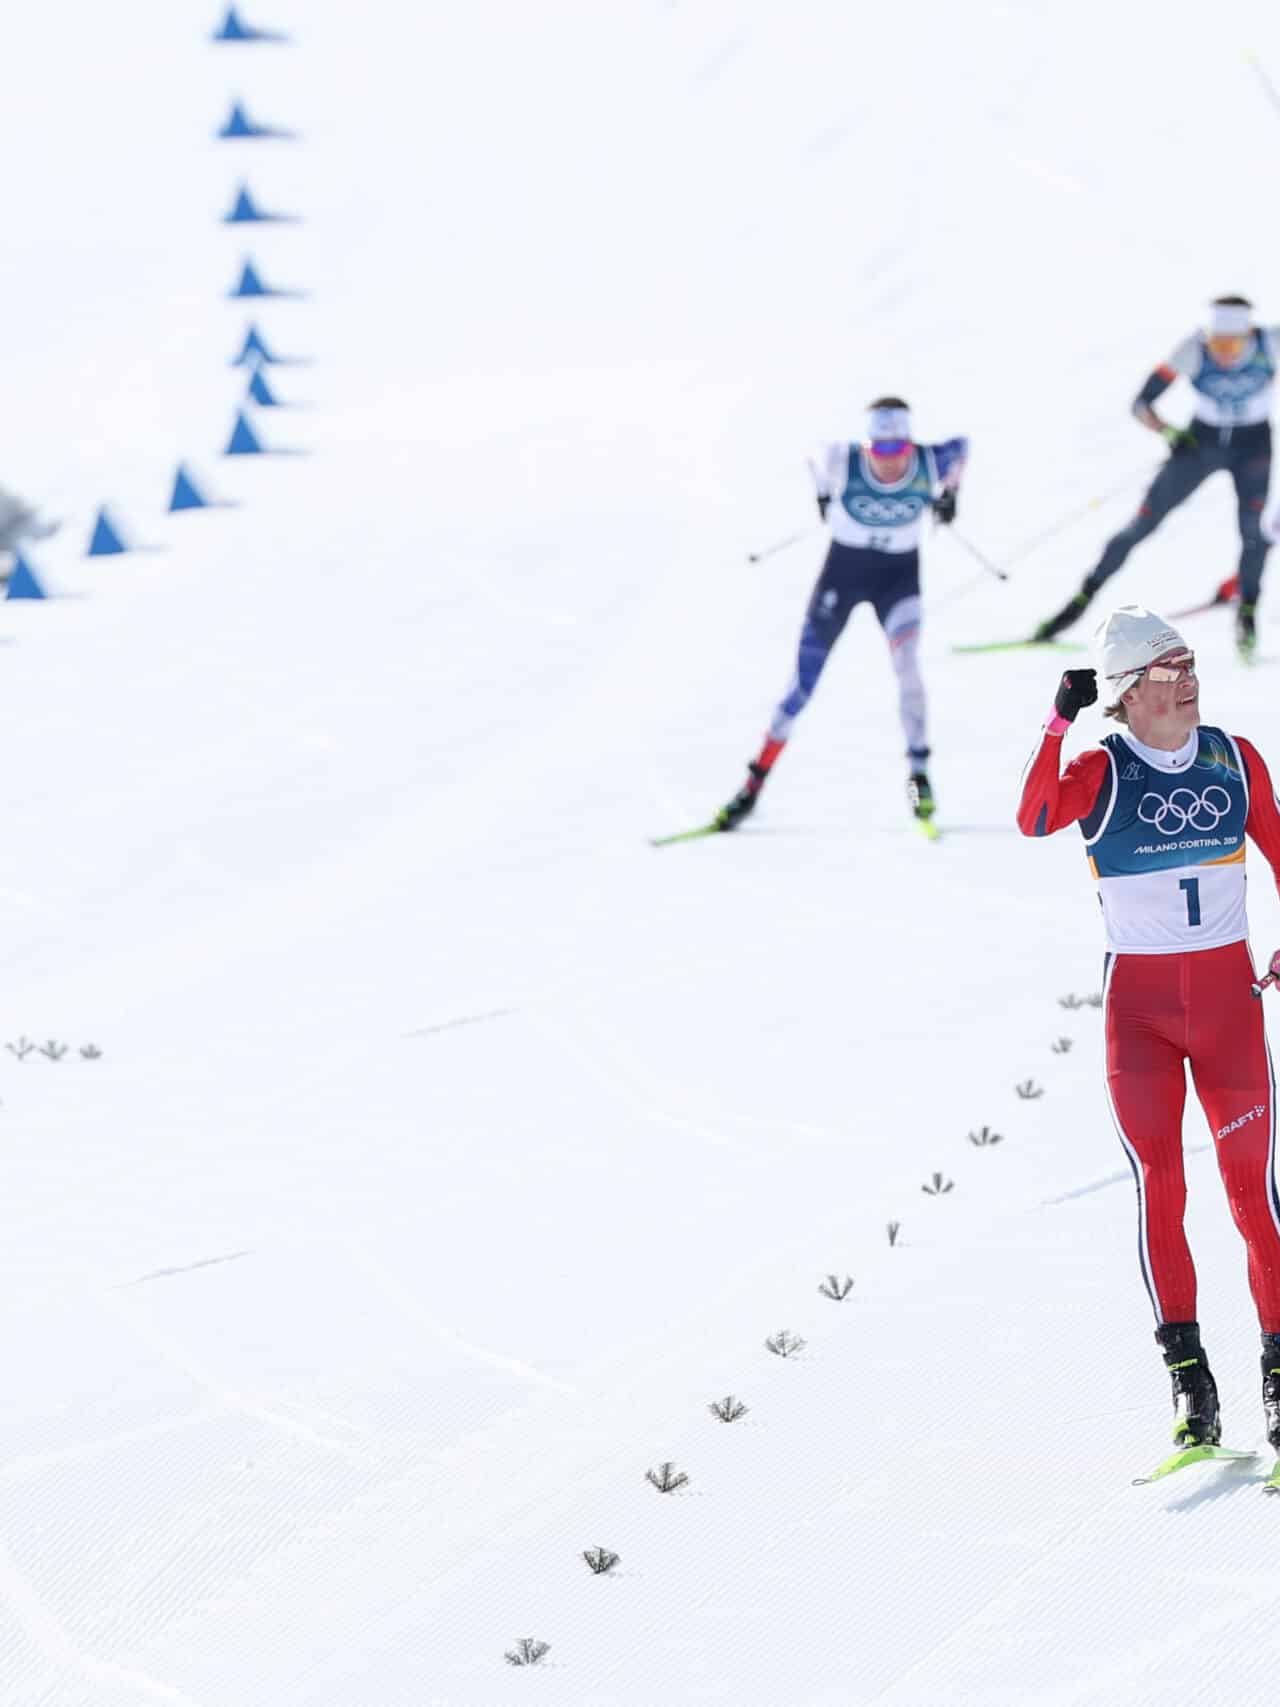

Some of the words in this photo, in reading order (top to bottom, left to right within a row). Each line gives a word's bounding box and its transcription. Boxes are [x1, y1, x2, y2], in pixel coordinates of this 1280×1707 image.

[1134, 843, 1177, 854] MILANO
[1179, 838, 1221, 849] CORTINA
[1179, 877, 1201, 926] 1
[1217, 1110, 1256, 1139] CRAFT
